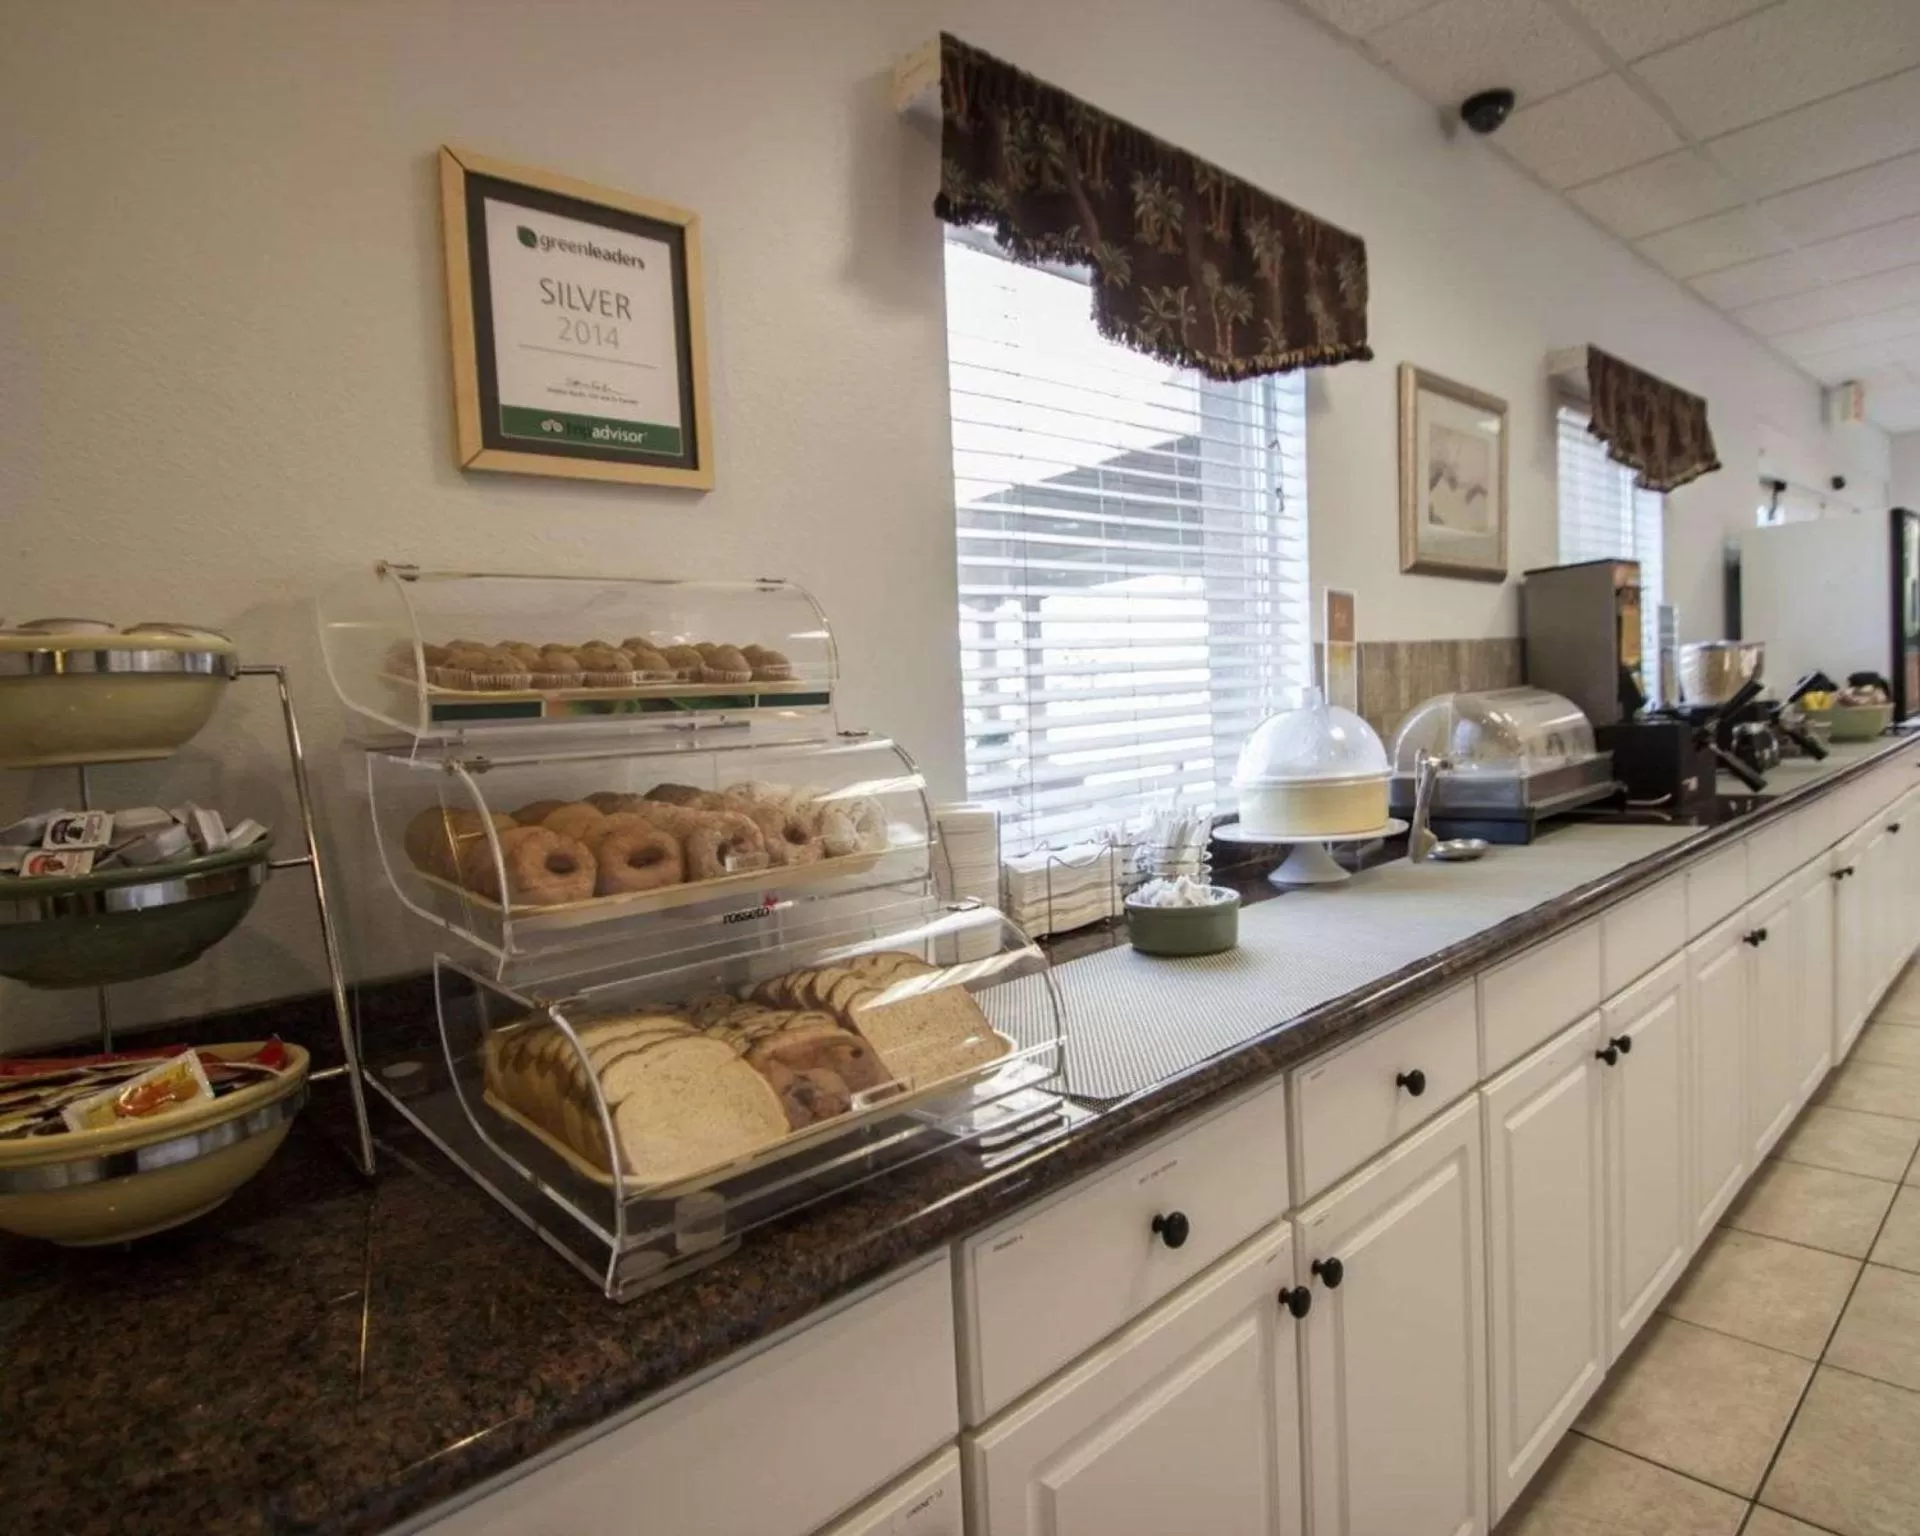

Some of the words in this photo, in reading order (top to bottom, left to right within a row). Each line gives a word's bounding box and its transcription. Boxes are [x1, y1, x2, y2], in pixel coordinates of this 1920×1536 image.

[540, 234, 645, 270] greenleaders
[539, 277, 632, 321] SILVER
[557, 316, 619, 350] 2014
[566, 420, 644, 444] tadvisor
